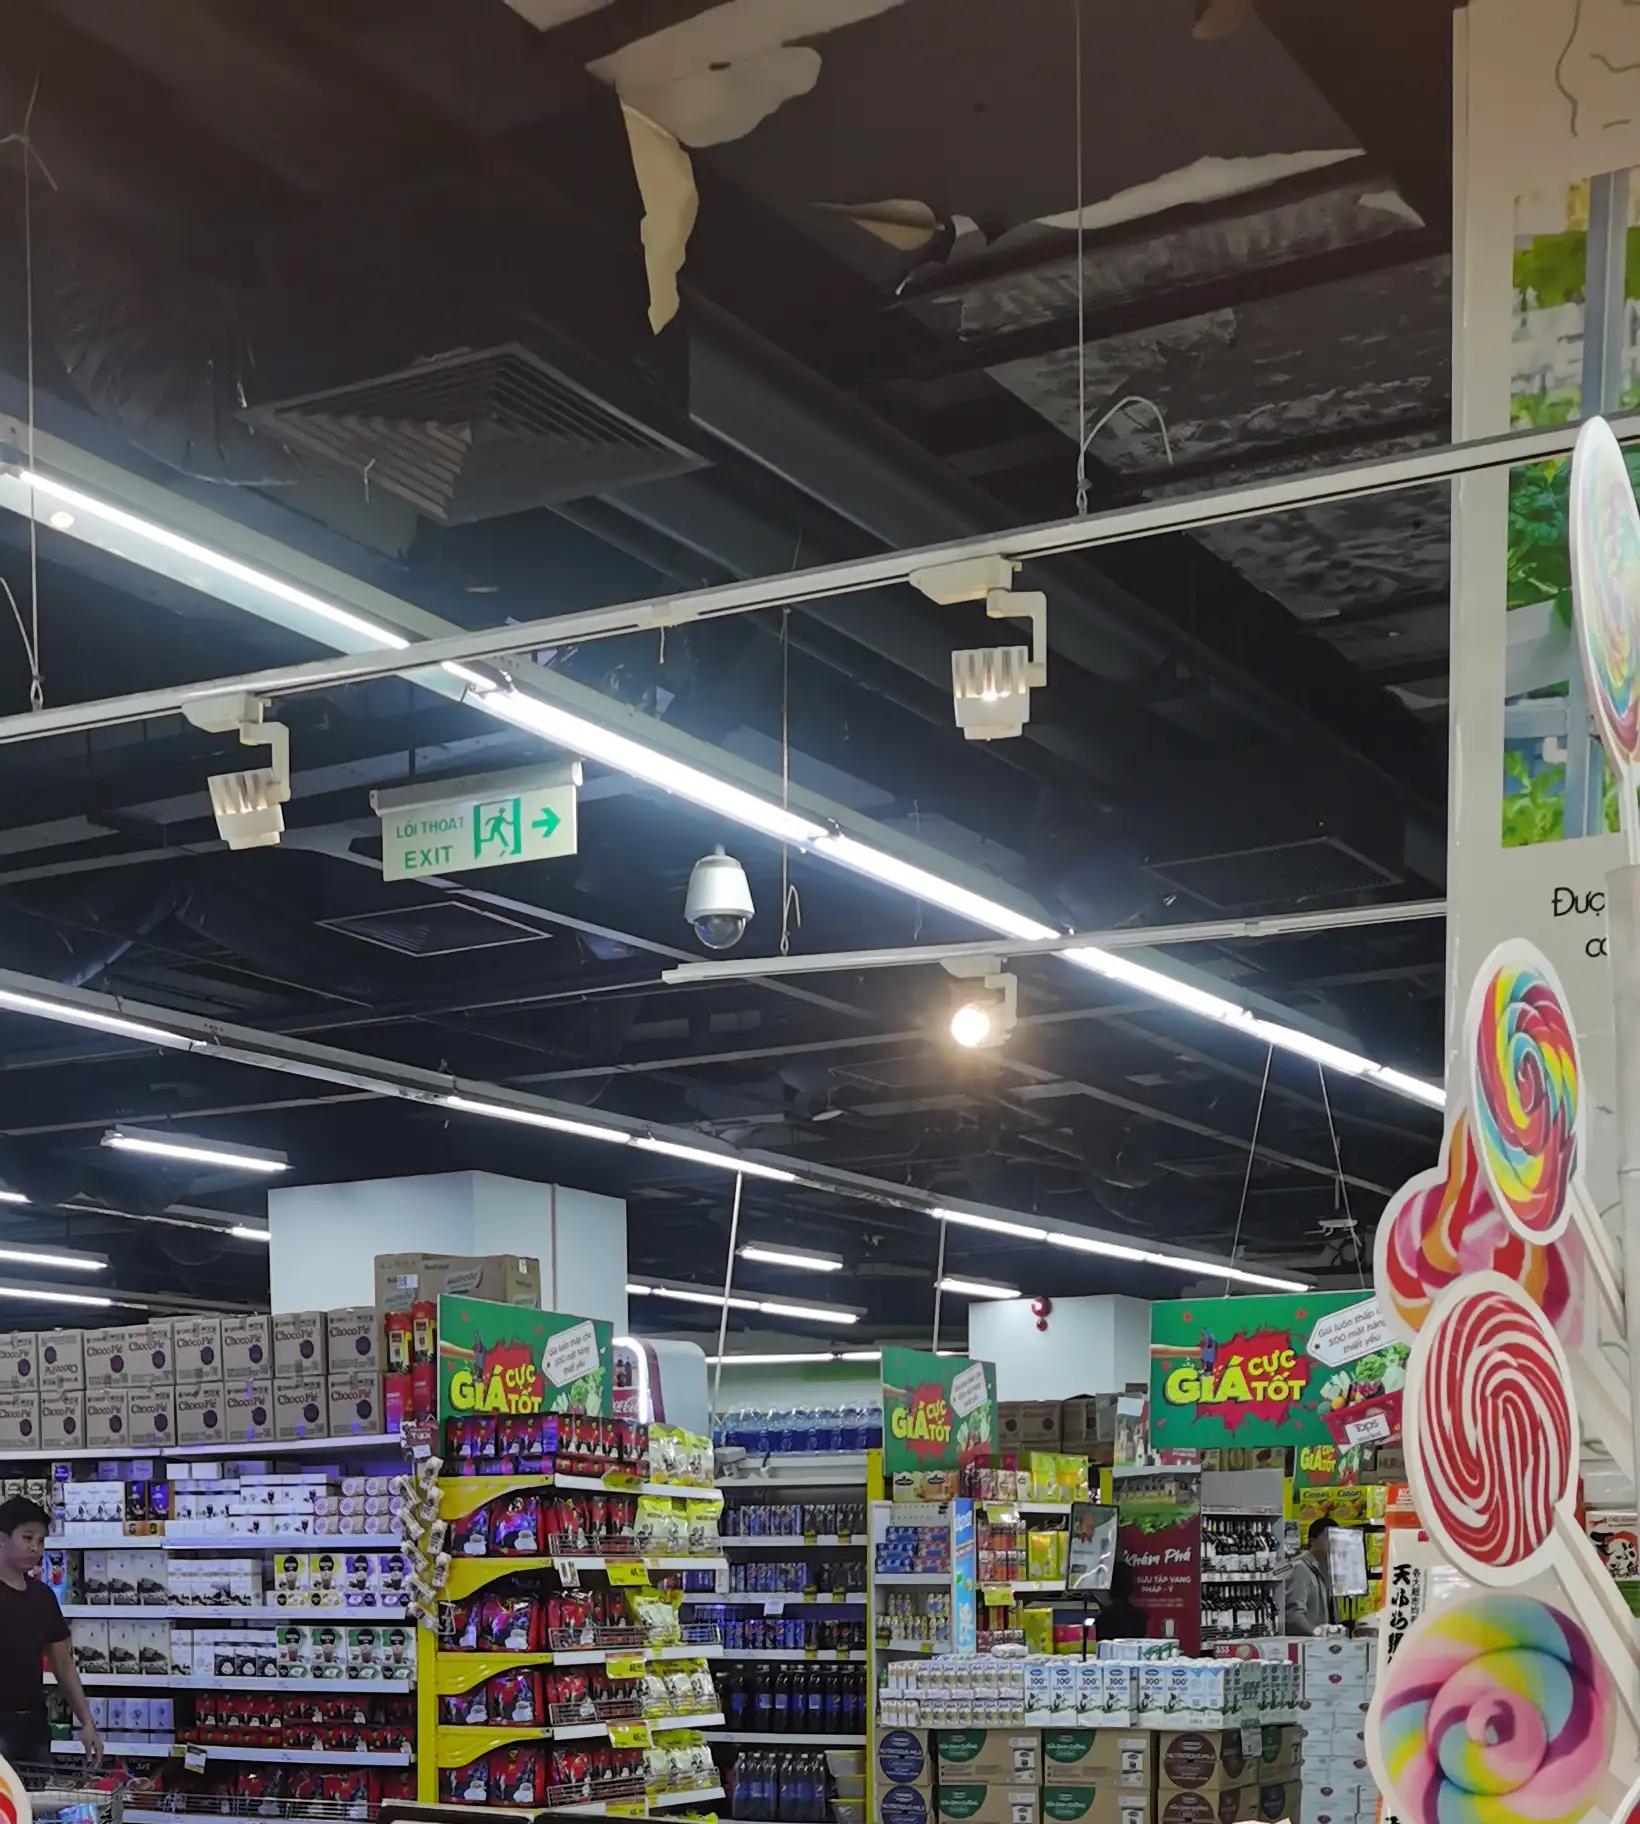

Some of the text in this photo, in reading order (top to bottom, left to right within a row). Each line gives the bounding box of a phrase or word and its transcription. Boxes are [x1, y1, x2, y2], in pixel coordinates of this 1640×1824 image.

[404, 845, 454, 870] EXIT
[1247, 1349, 1297, 1377] CỰC
[450, 1364, 509, 1414] GIÁ
[505, 1363, 536, 1391] CỰC
[1165, 1355, 1253, 1405] GIÁ
[1250, 1371, 1306, 1401] TỐT
[507, 1389, 543, 1414] TỐT
[926, 1399, 947, 1419] CỰC
[928, 1417, 951, 1442] TỐT
[1353, 1420, 1379, 1433] Tops
[1164, 1546, 1192, 1564] Phá
